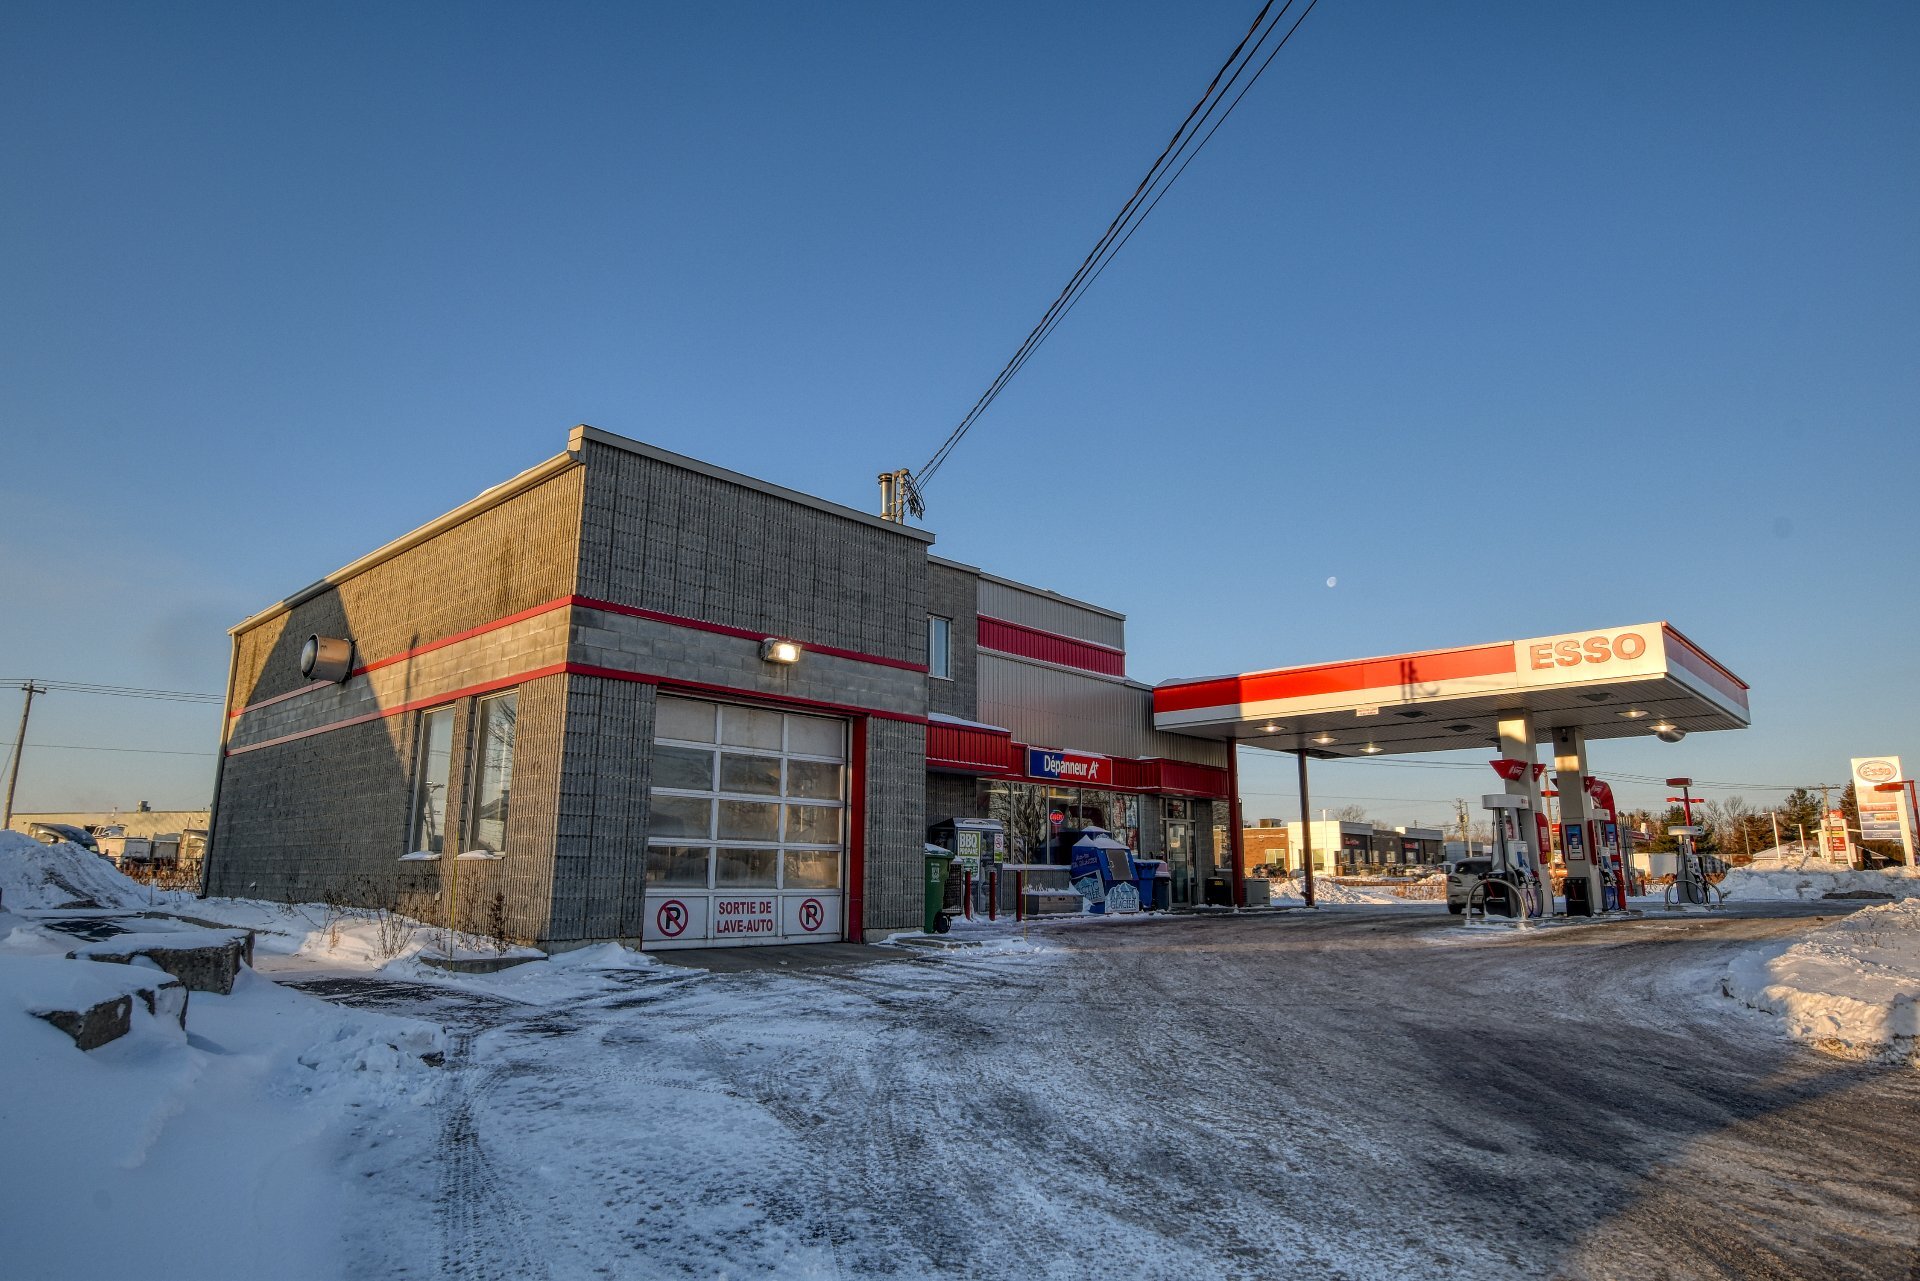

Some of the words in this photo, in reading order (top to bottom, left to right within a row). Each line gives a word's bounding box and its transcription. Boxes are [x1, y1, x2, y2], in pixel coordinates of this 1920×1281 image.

[1529, 633, 1646, 670] ESSO
[1044, 754, 1087, 776] Dépanneur
[959, 833, 978, 848] BBQ
[718, 901, 756, 915] SORTIE
[759, 901, 772, 914] DE
[1110, 900, 1136, 909] GLACIER
[717, 918, 773, 934] LAVE-AUTO
